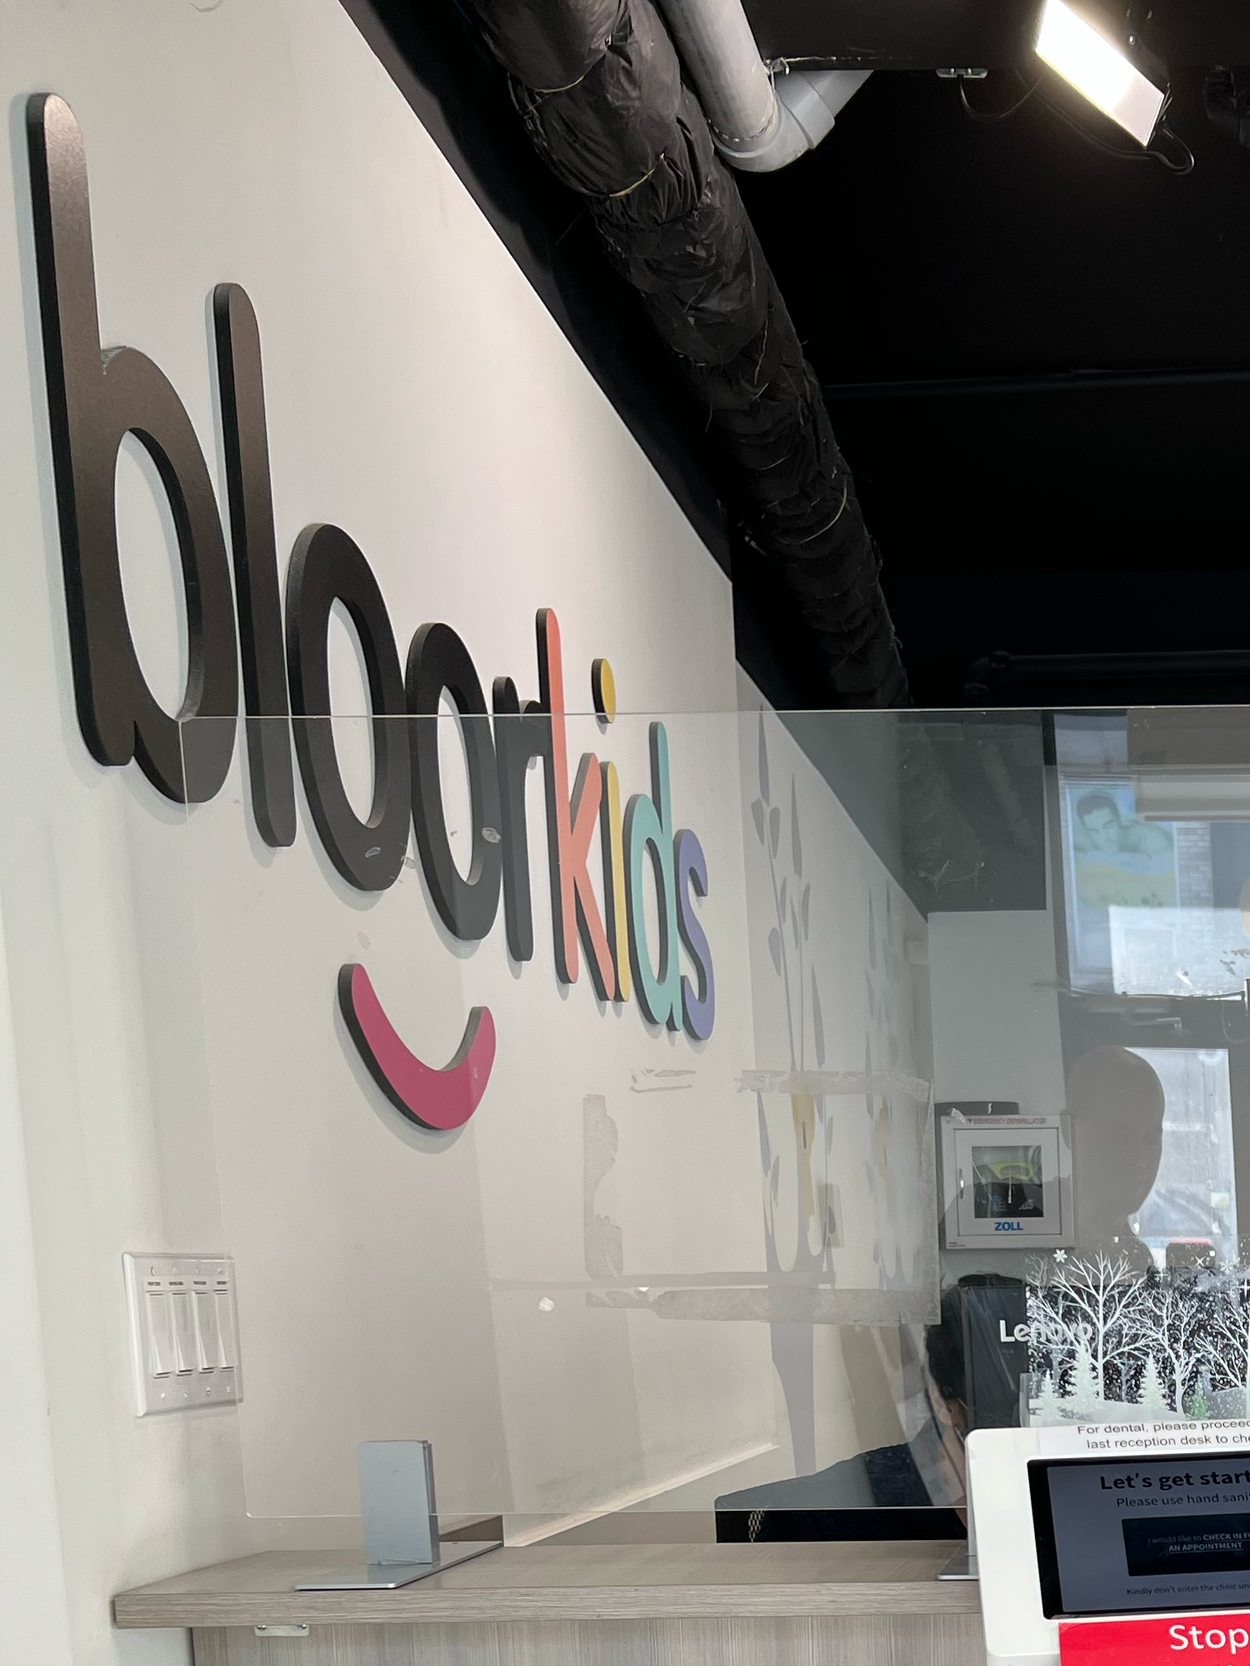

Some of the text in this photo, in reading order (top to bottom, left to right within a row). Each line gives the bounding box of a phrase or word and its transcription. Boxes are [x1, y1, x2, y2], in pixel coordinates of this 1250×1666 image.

[26, 92, 715, 1041] bloorkids
[994, 1221, 1023, 1231] ZOLL
[999, 1319, 1093, 1342] Lenovo
[1078, 1425, 1100, 1435] For
[1104, 1423, 1149, 1434] dental,
[1153, 1422, 1197, 1433] please
[1086, 1439, 1111, 1449] last
[1115, 1437, 1176, 1449] reception
[1180, 1434, 1212, 1445] desk
[1215, 1434, 1228, 1444] to
[1158, 1472, 1194, 1491] get
[1116, 1497, 1158, 1507] Please
[1162, 1496, 1183, 1506] use
[1187, 1493, 1220, 1504] hand
[1152, 1535, 1176, 1543] would
[1178, 1534, 1192, 1543] like
[1203, 1533, 1231, 1541] CHECK
[1233, 1532, 1242, 1540] IN
[1168, 1541, 1243, 1552] AN APPOINTMENT
[1126, 1587, 1152, 1597] Kindly
[1177, 1585, 1199, 1593] enter
[1200, 1583, 1214, 1592] the
[1215, 1581, 1237, 1591] clinic
